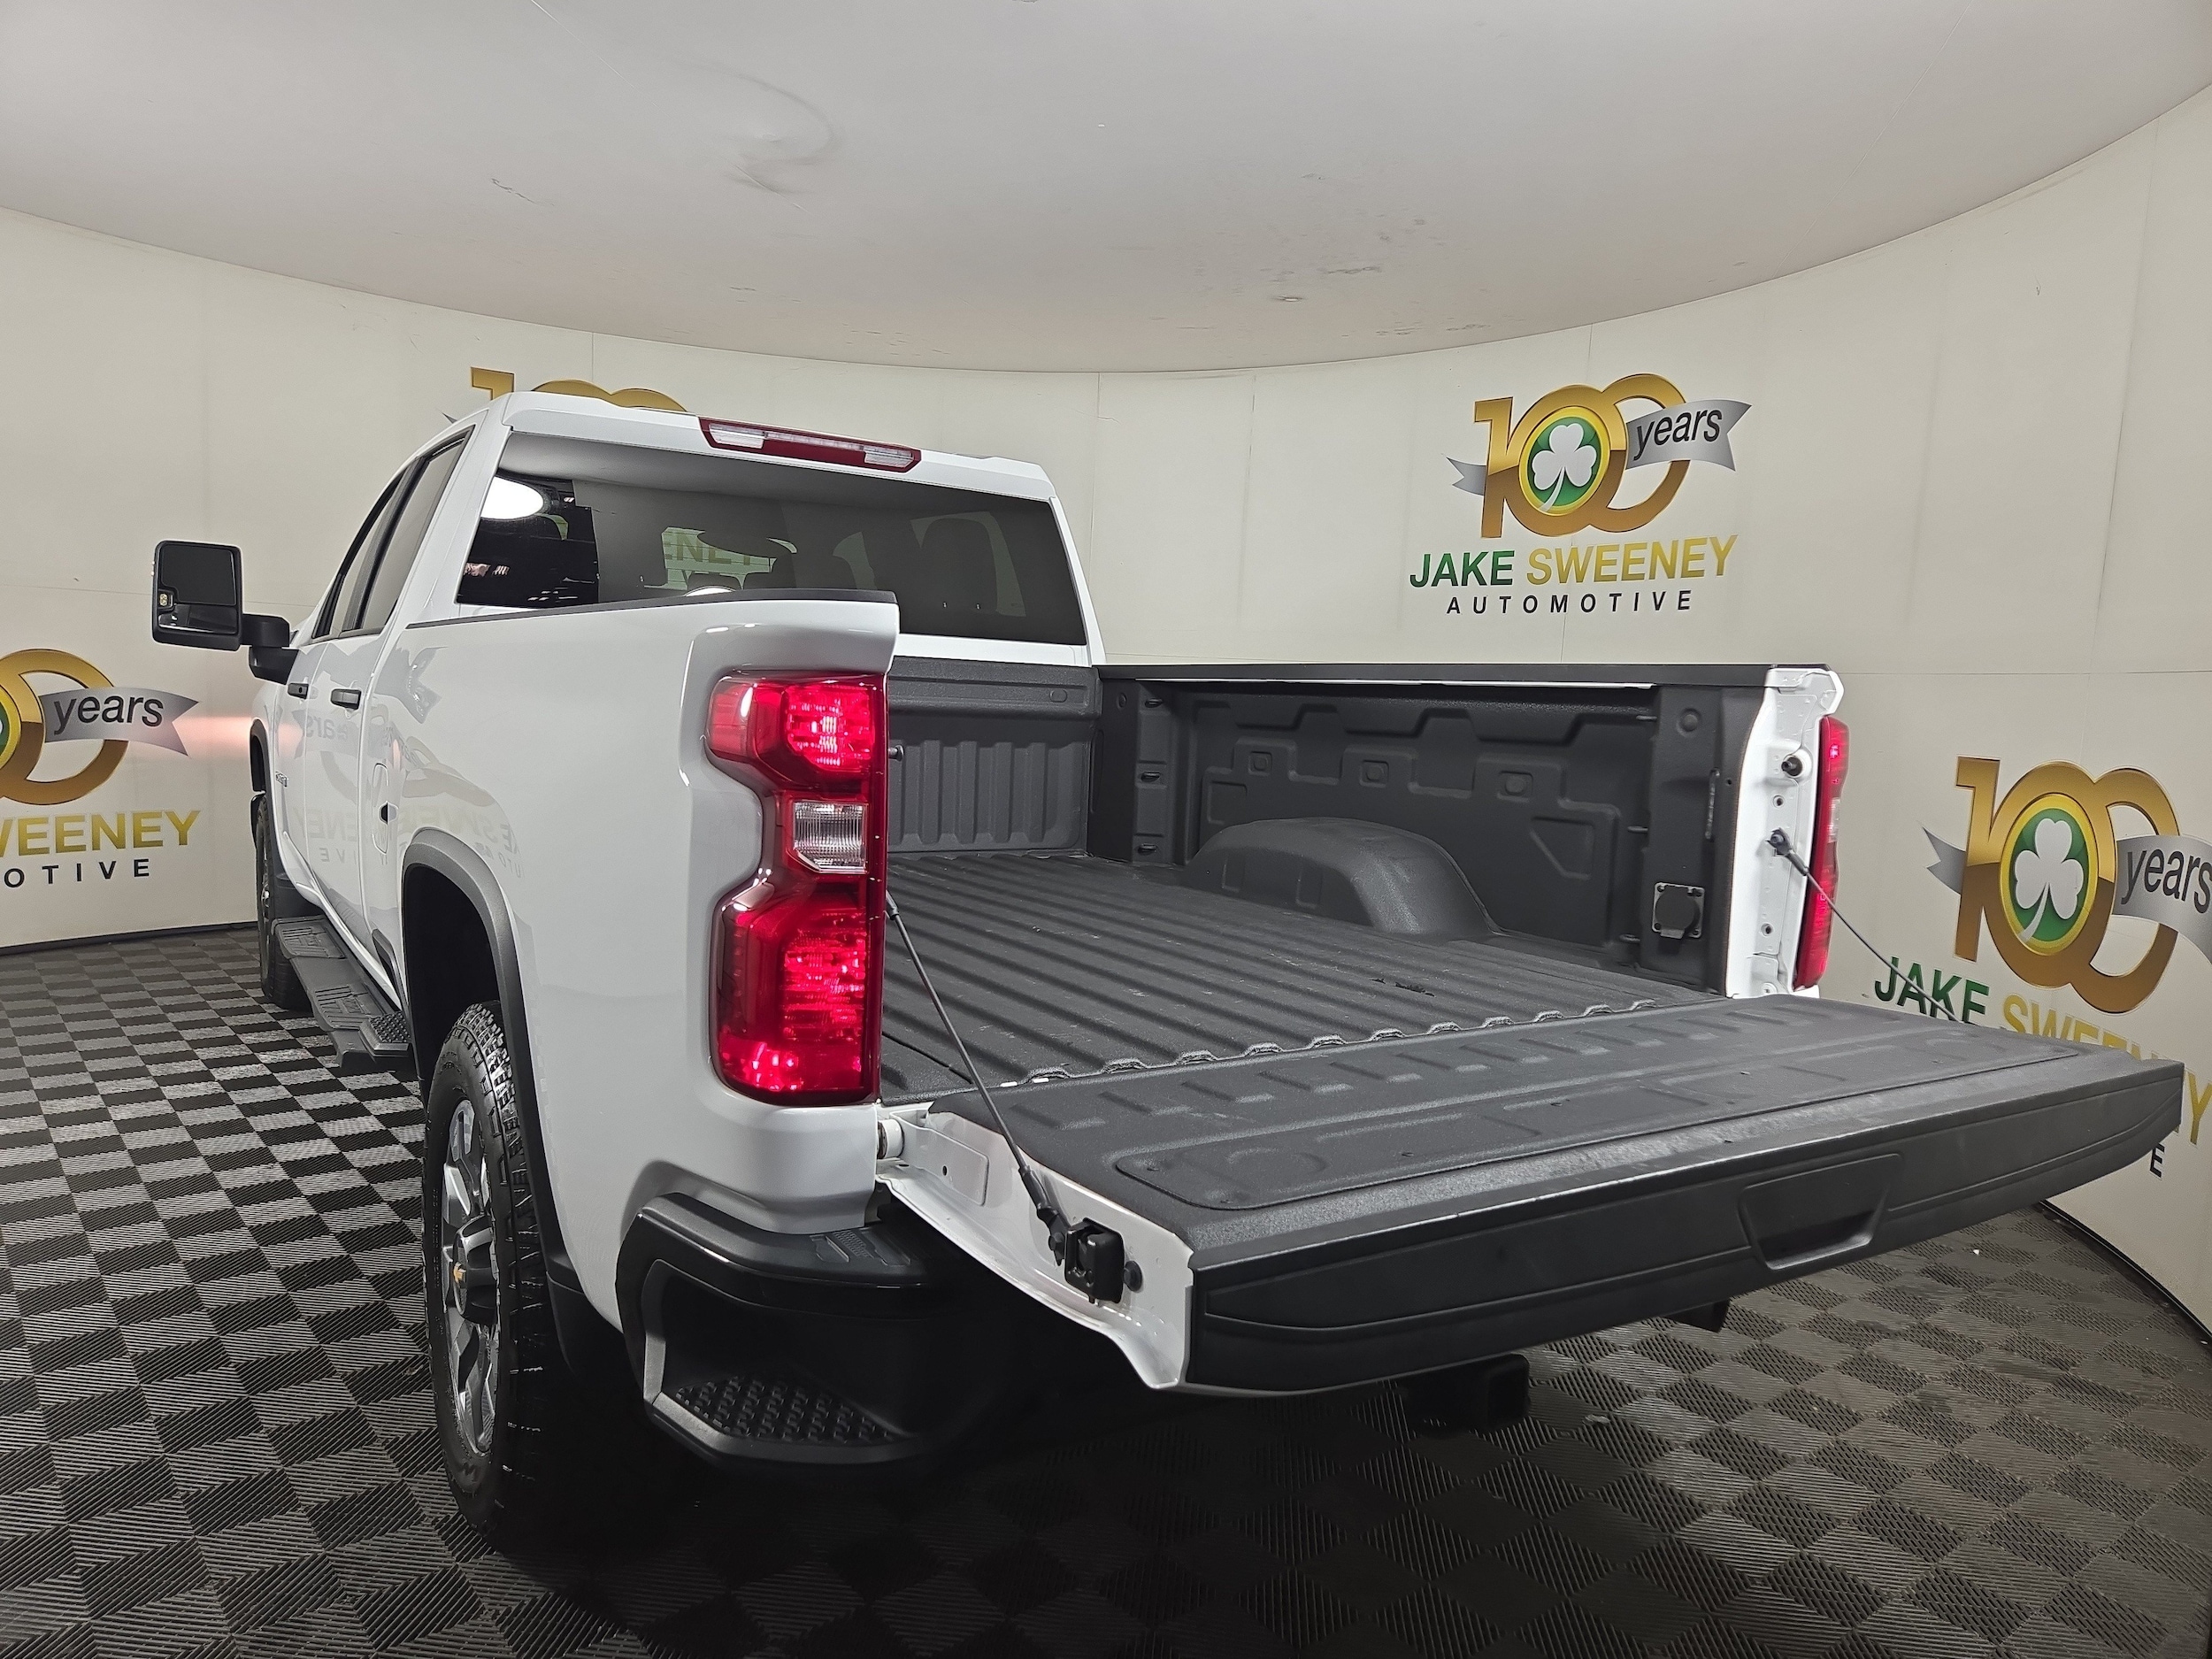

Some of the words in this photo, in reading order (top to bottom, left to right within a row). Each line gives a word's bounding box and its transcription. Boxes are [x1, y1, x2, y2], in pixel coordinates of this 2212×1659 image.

[1474, 373, 1691, 538] 100
[1633, 408, 1723, 461] years
[1409, 549, 1515, 588] JAKE
[1526, 534, 1739, 585] SWEENEY
[1447, 590, 1692, 614] AUTOMOTIVE
[53, 695, 164, 735] years
[1954, 756, 2180, 1014] 100
[2121, 849, 2212, 913] years
